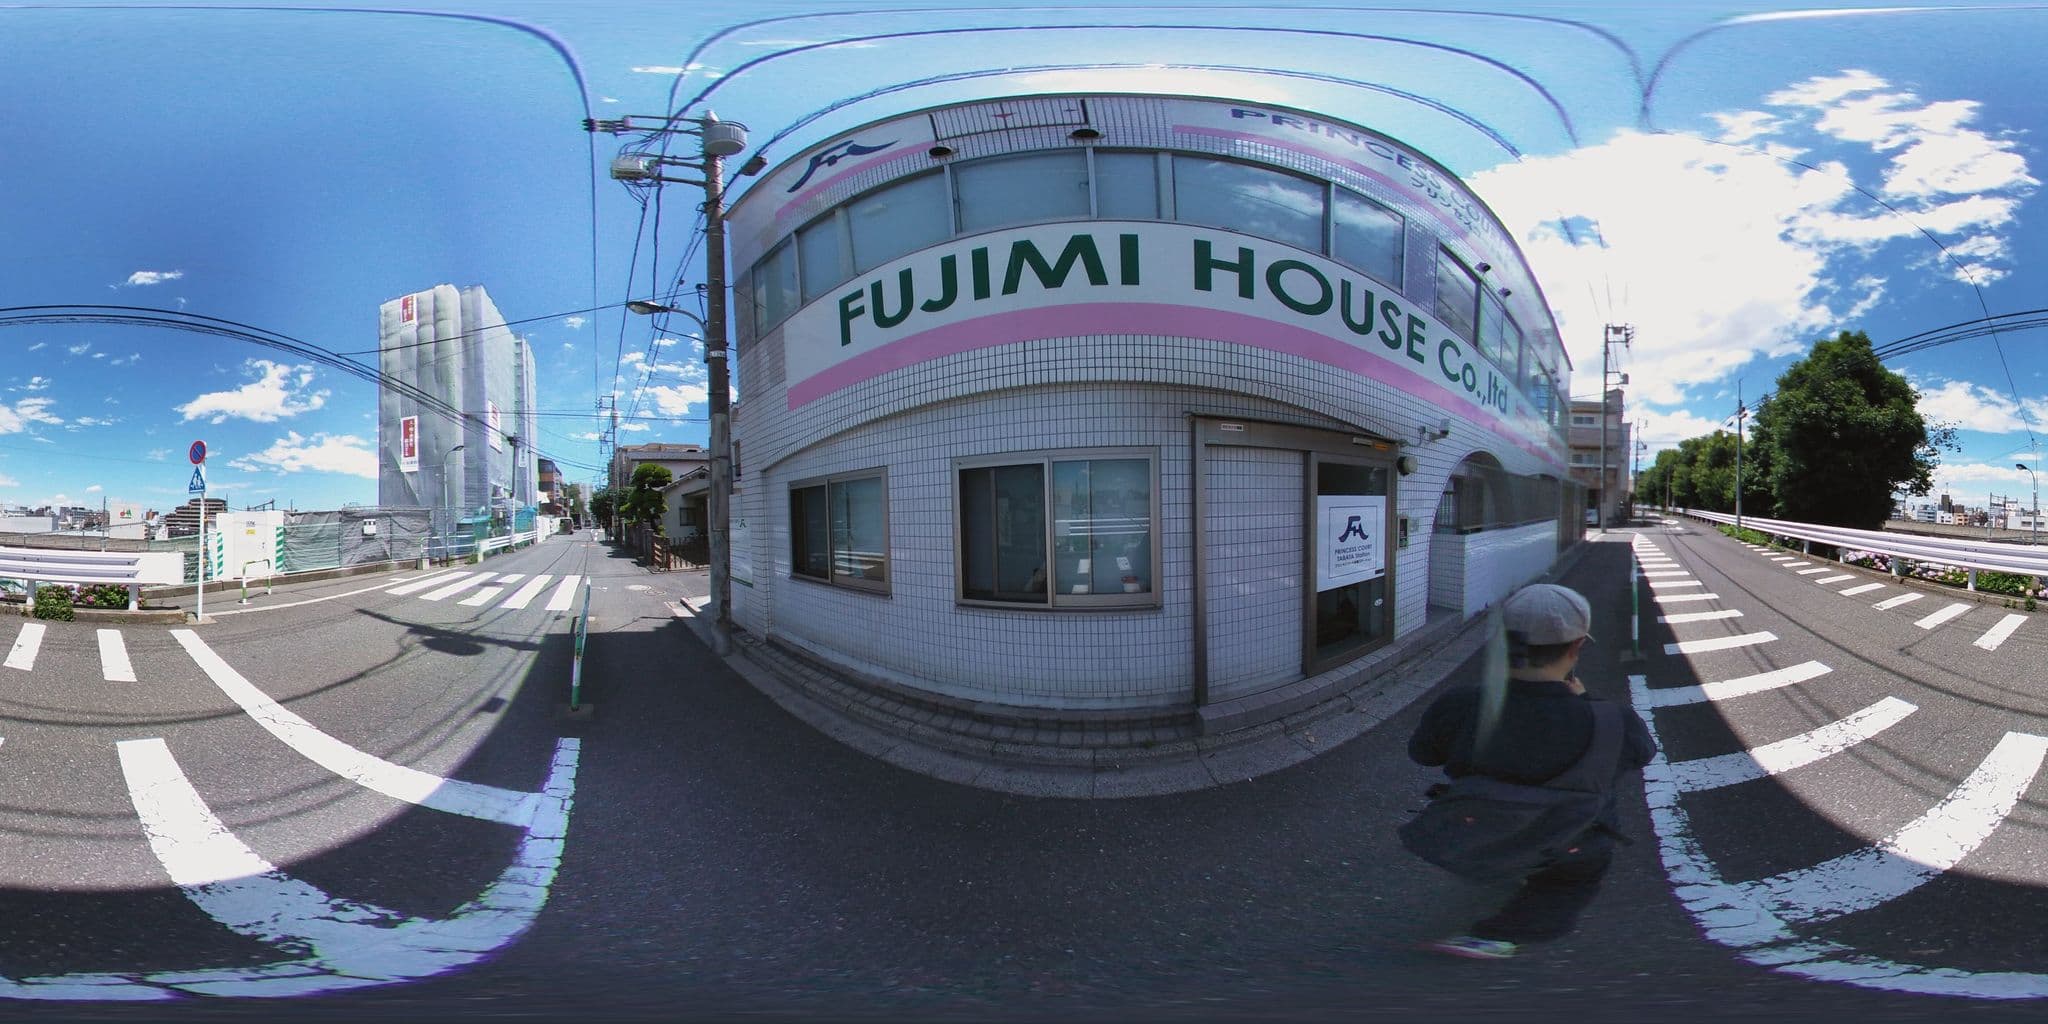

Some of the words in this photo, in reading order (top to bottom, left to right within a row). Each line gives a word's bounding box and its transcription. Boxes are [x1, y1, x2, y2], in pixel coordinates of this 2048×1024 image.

[1231, 108, 1442, 190] PRINCESS
[839, 234, 1140, 347] FUJIMI
[1193, 239, 1426, 364] HOUSE
